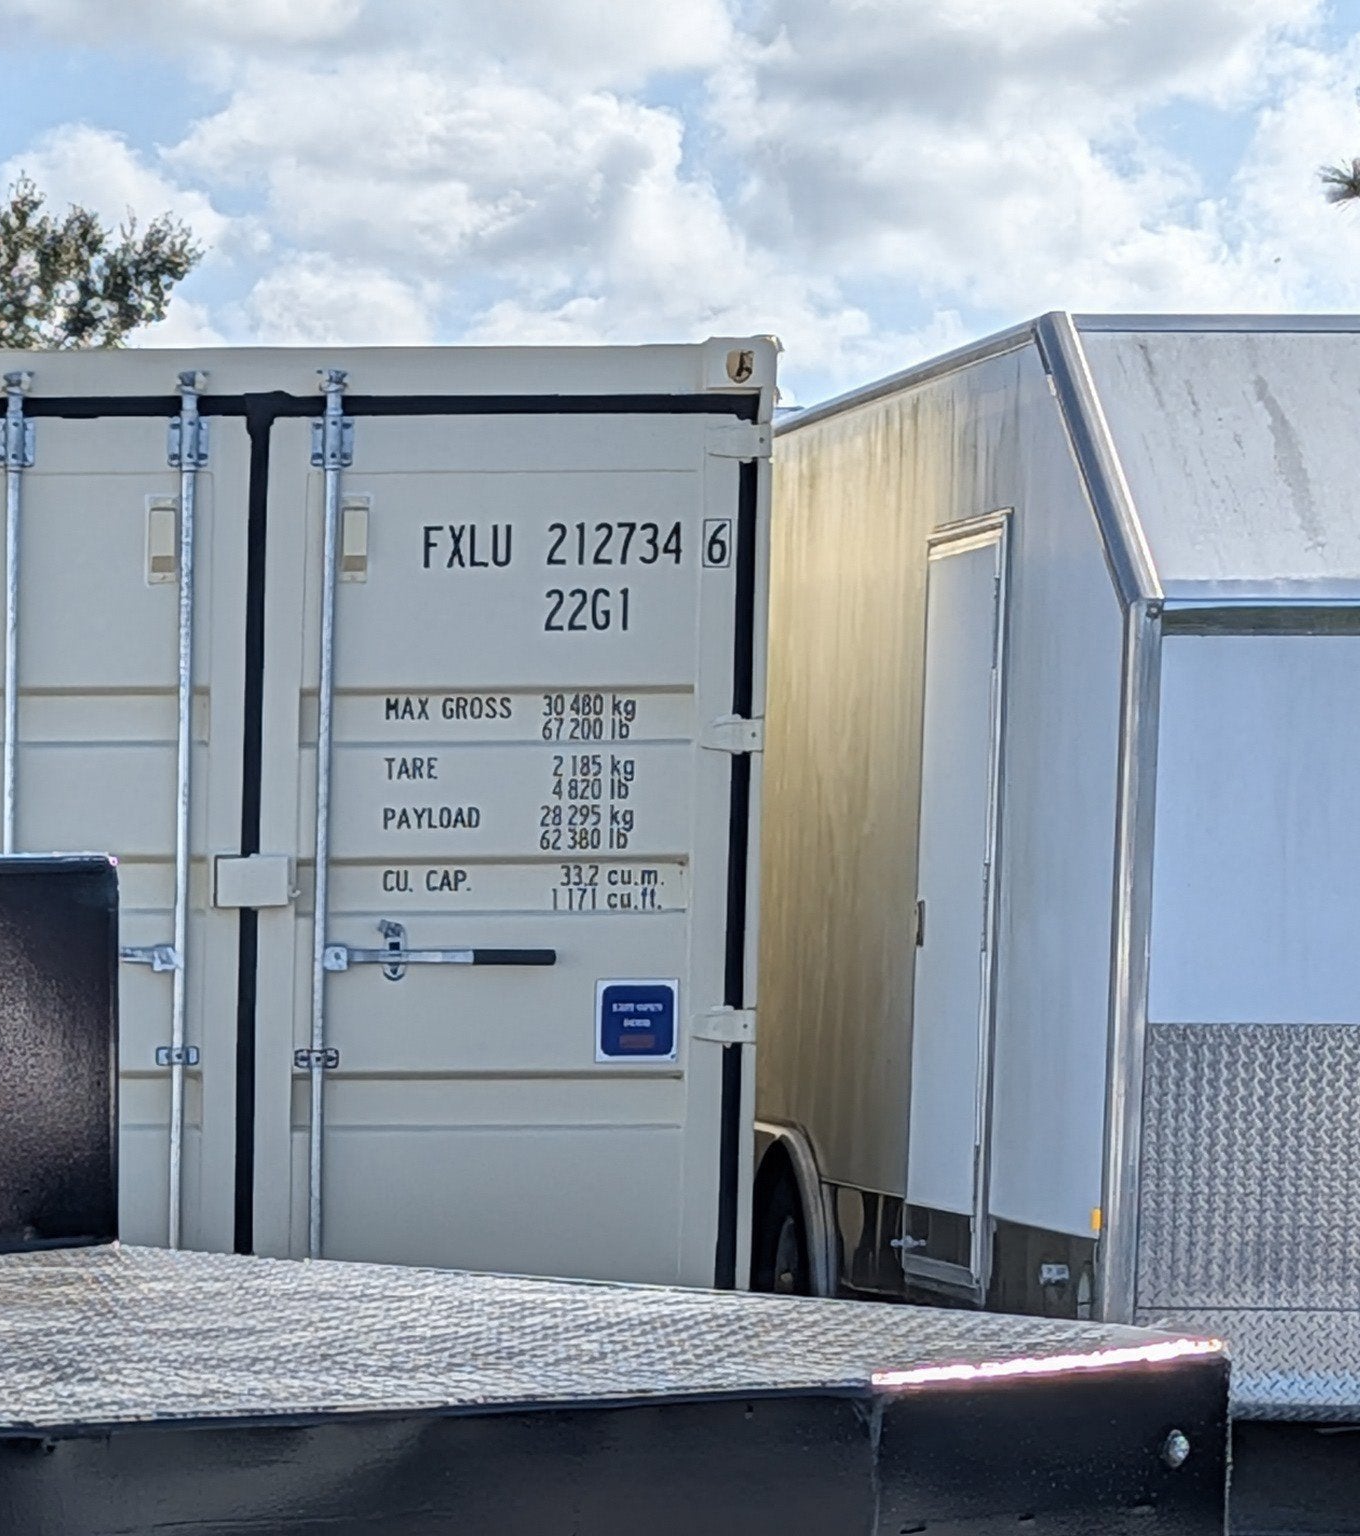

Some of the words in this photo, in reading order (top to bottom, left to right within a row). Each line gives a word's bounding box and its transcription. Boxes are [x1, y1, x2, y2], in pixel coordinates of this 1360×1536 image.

[422, 523, 513, 569] FXLU
[546, 521, 683, 566] 212734
[706, 522, 728, 565] 6
[543, 587, 630, 632] 22G1
[384, 697, 430, 721] MAX
[441, 696, 513, 720] GROSS
[610, 694, 637, 723] kg
[610, 717, 631, 740] lb
[384, 756, 439, 781] TARE
[610, 754, 636, 783] kg
[610, 777, 630, 800] lb
[382, 807, 481, 831] PAYLOAD
[609, 804, 635, 832] kg
[608, 828, 629, 850] lb
[382, 869, 414, 893] CU.
[425, 869, 472, 893] CAP.
[559, 864, 600, 887] 33.2
[606, 867, 666, 887] cu.m.
[605, 886, 663, 911] cu.ft.
